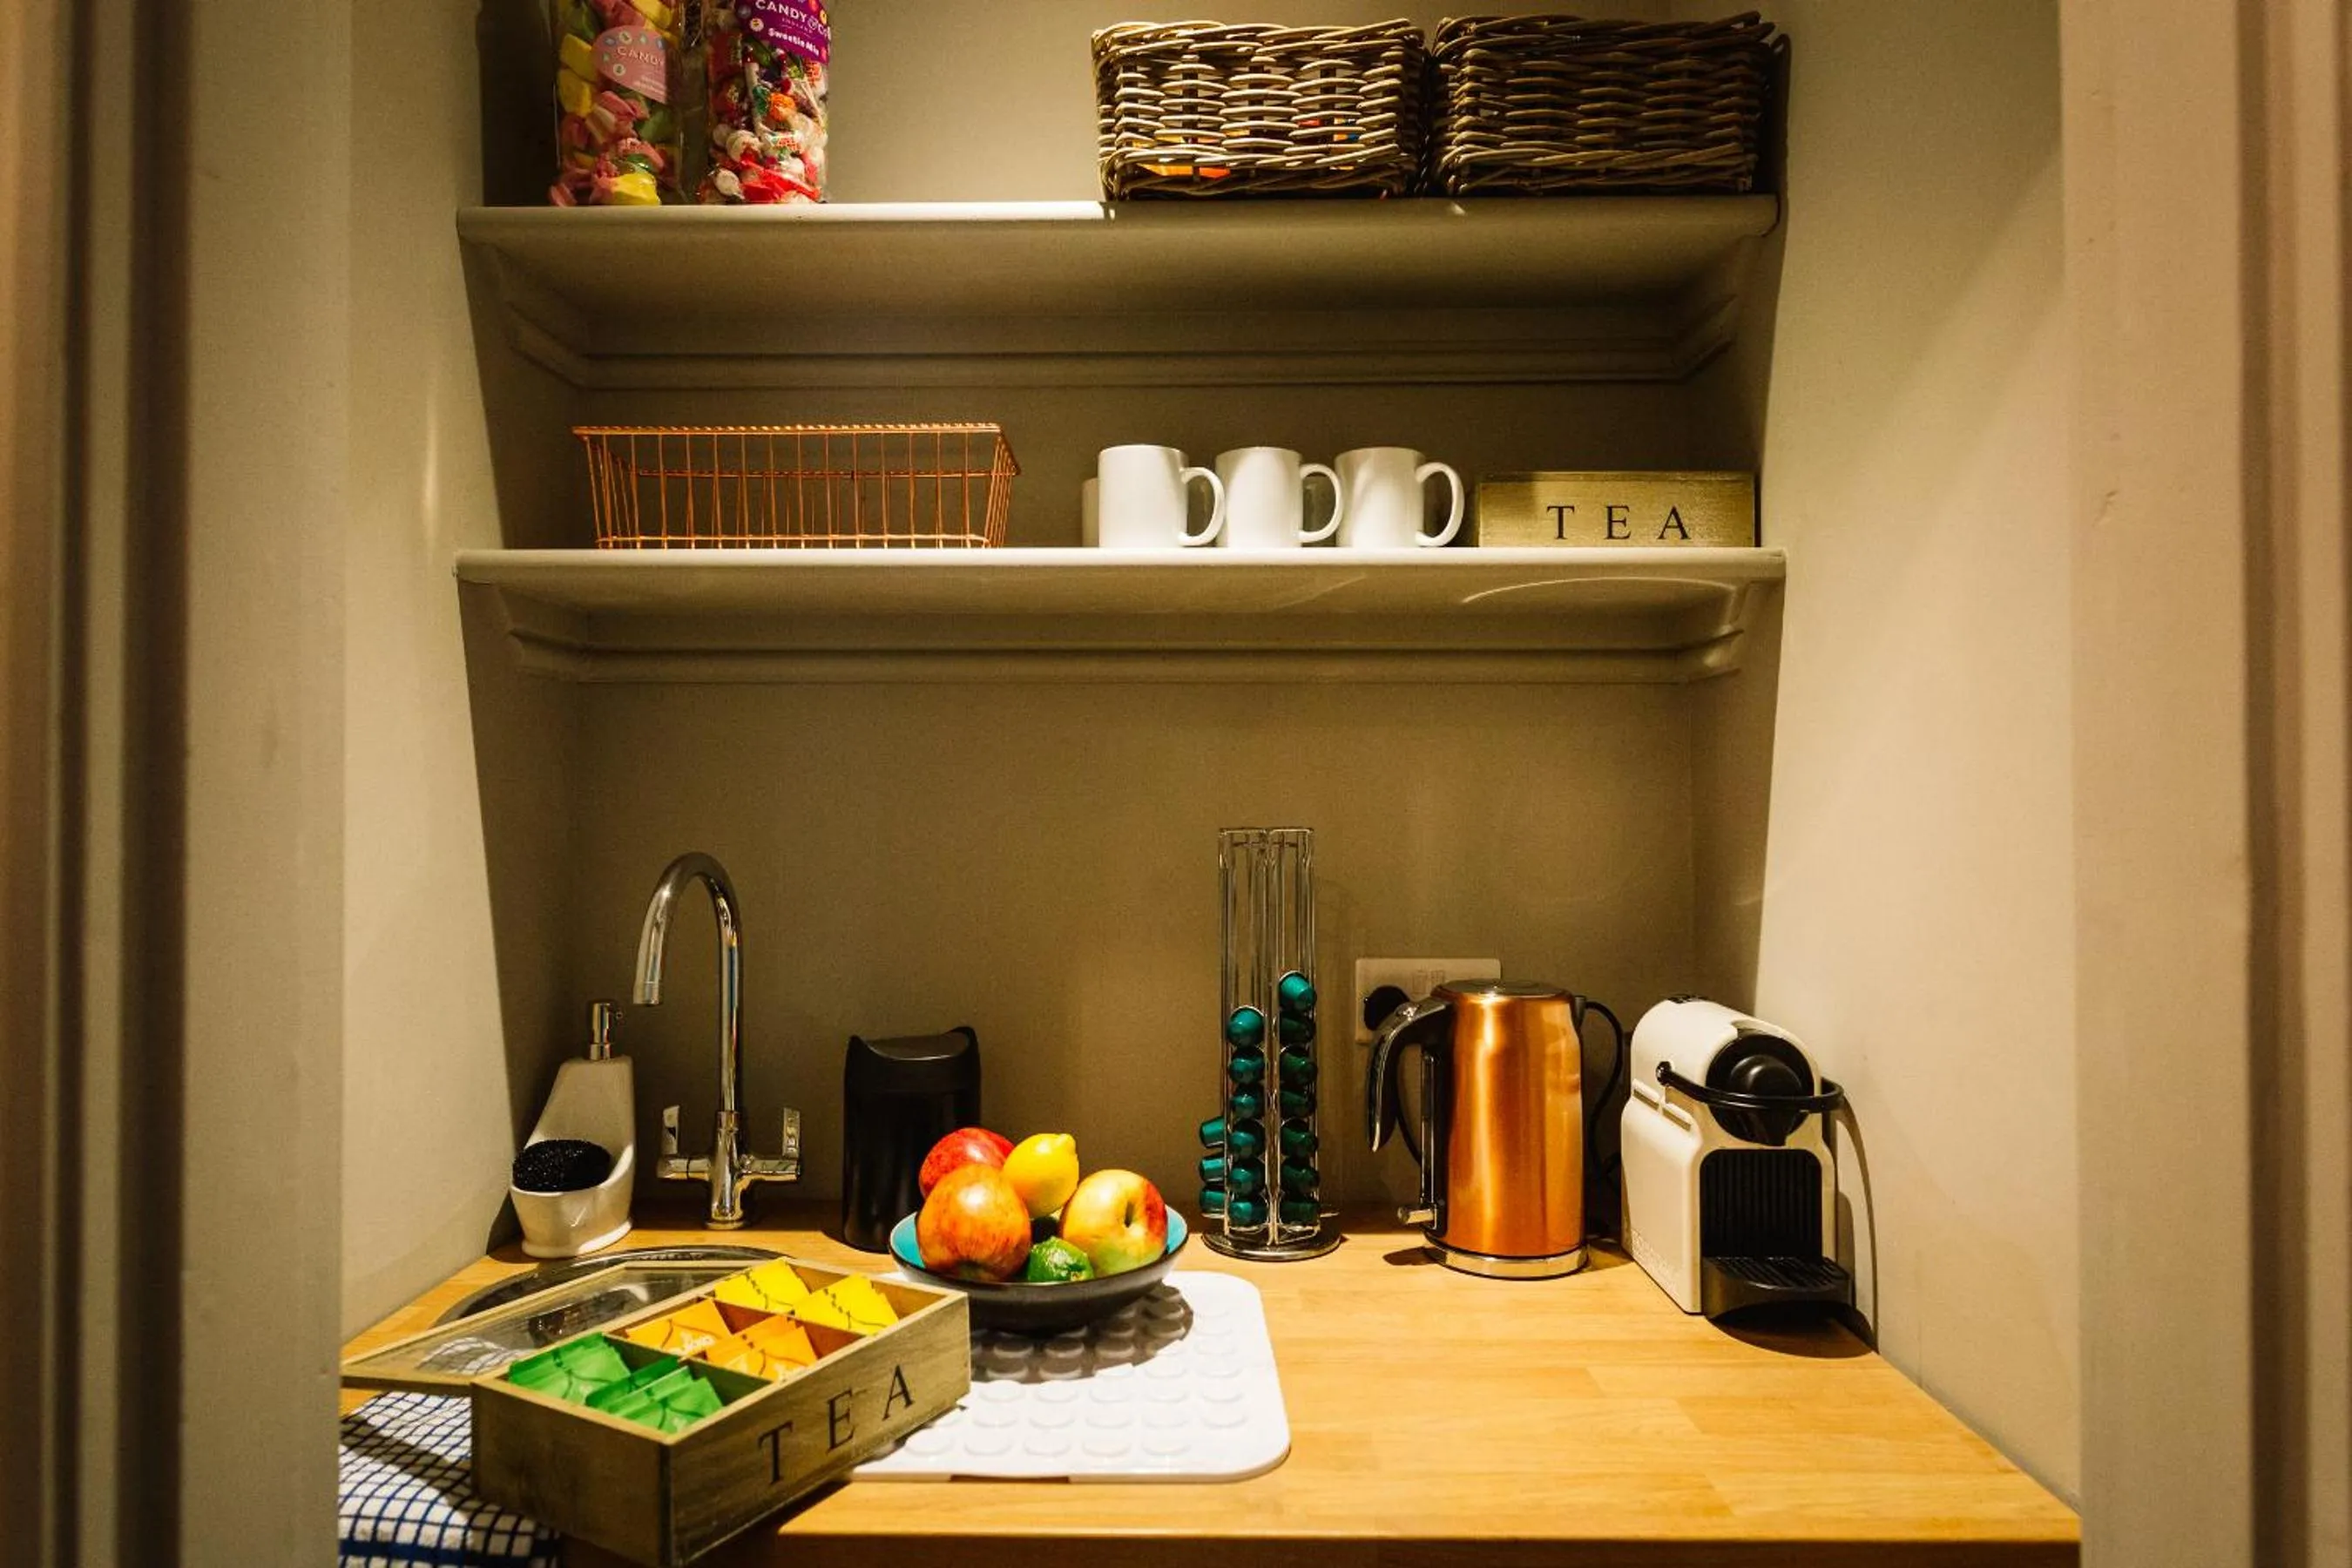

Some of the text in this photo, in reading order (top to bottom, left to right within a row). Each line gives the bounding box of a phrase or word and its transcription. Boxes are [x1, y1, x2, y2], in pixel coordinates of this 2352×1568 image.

[754, 0, 807, 22] CANDY
[1546, 505, 1691, 540] TEA
[758, 1364, 914, 1484] TEA
